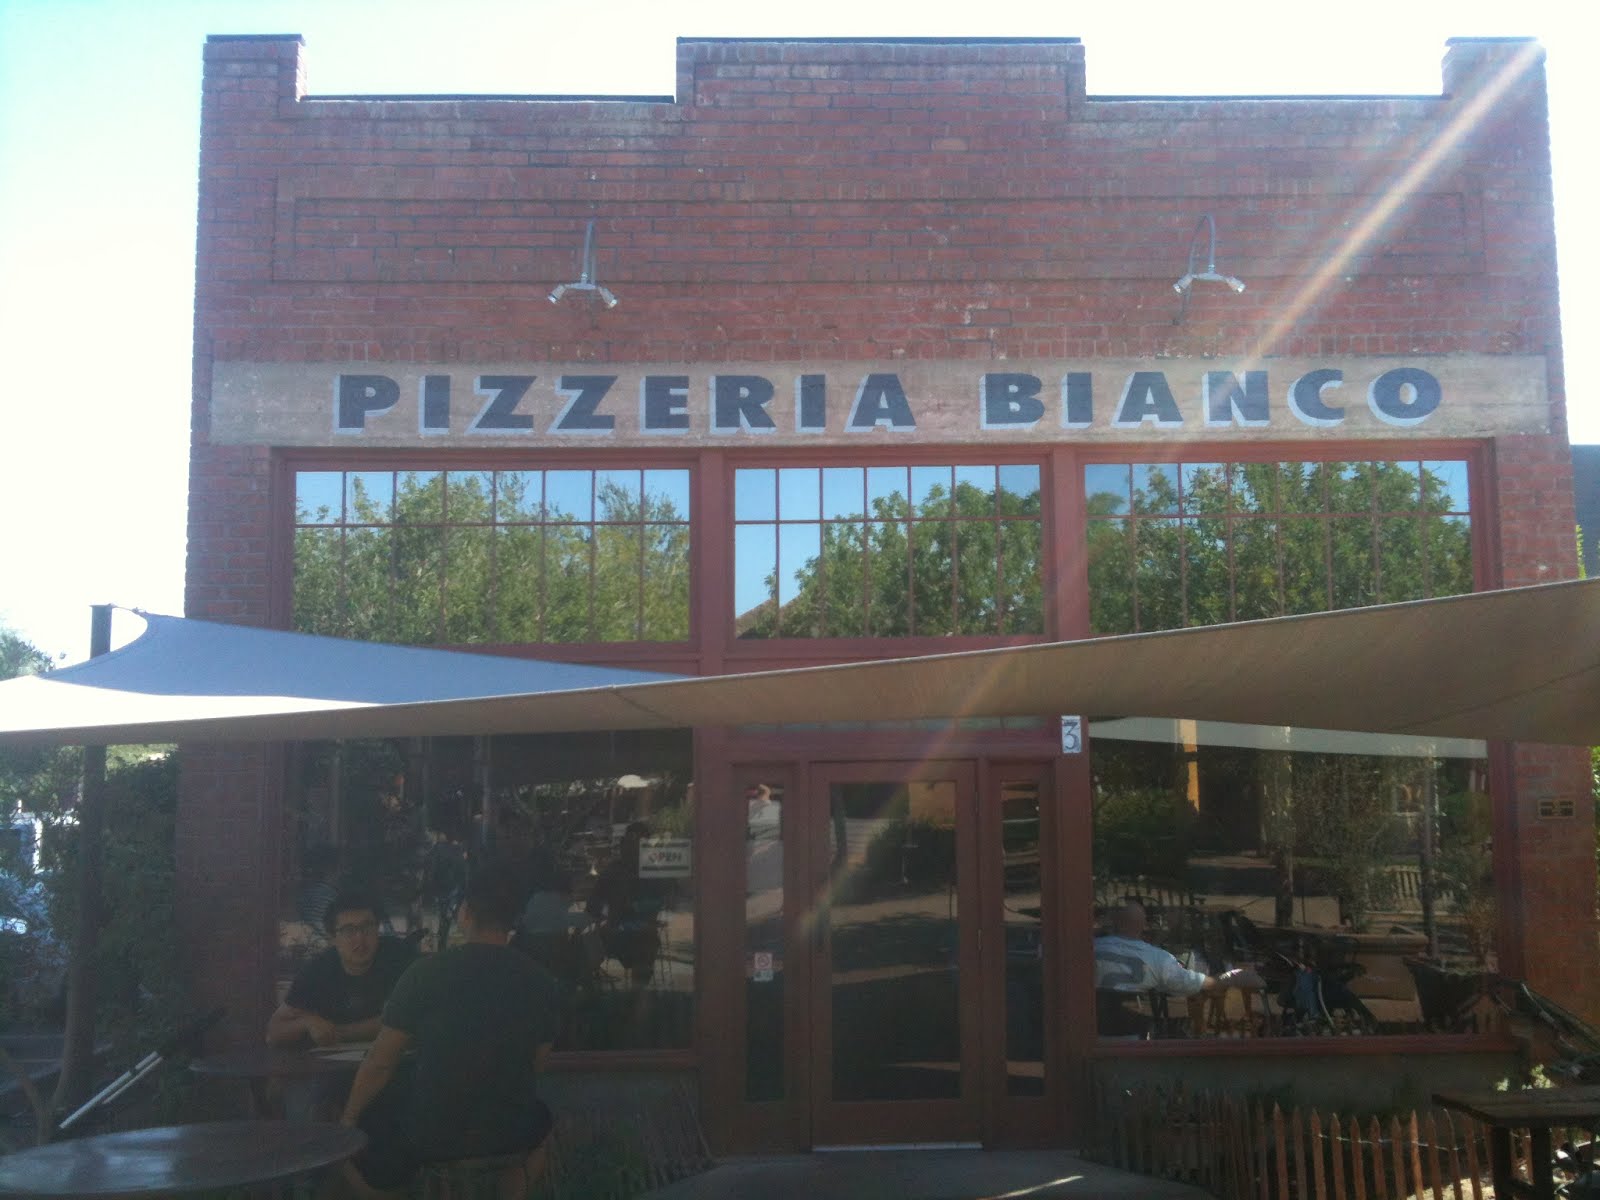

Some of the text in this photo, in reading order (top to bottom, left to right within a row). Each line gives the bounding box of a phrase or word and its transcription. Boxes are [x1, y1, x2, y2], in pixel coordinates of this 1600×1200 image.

[334, 367, 1442, 436] PIZZERIA BIANCO
[1062, 720, 1080, 750] 3
